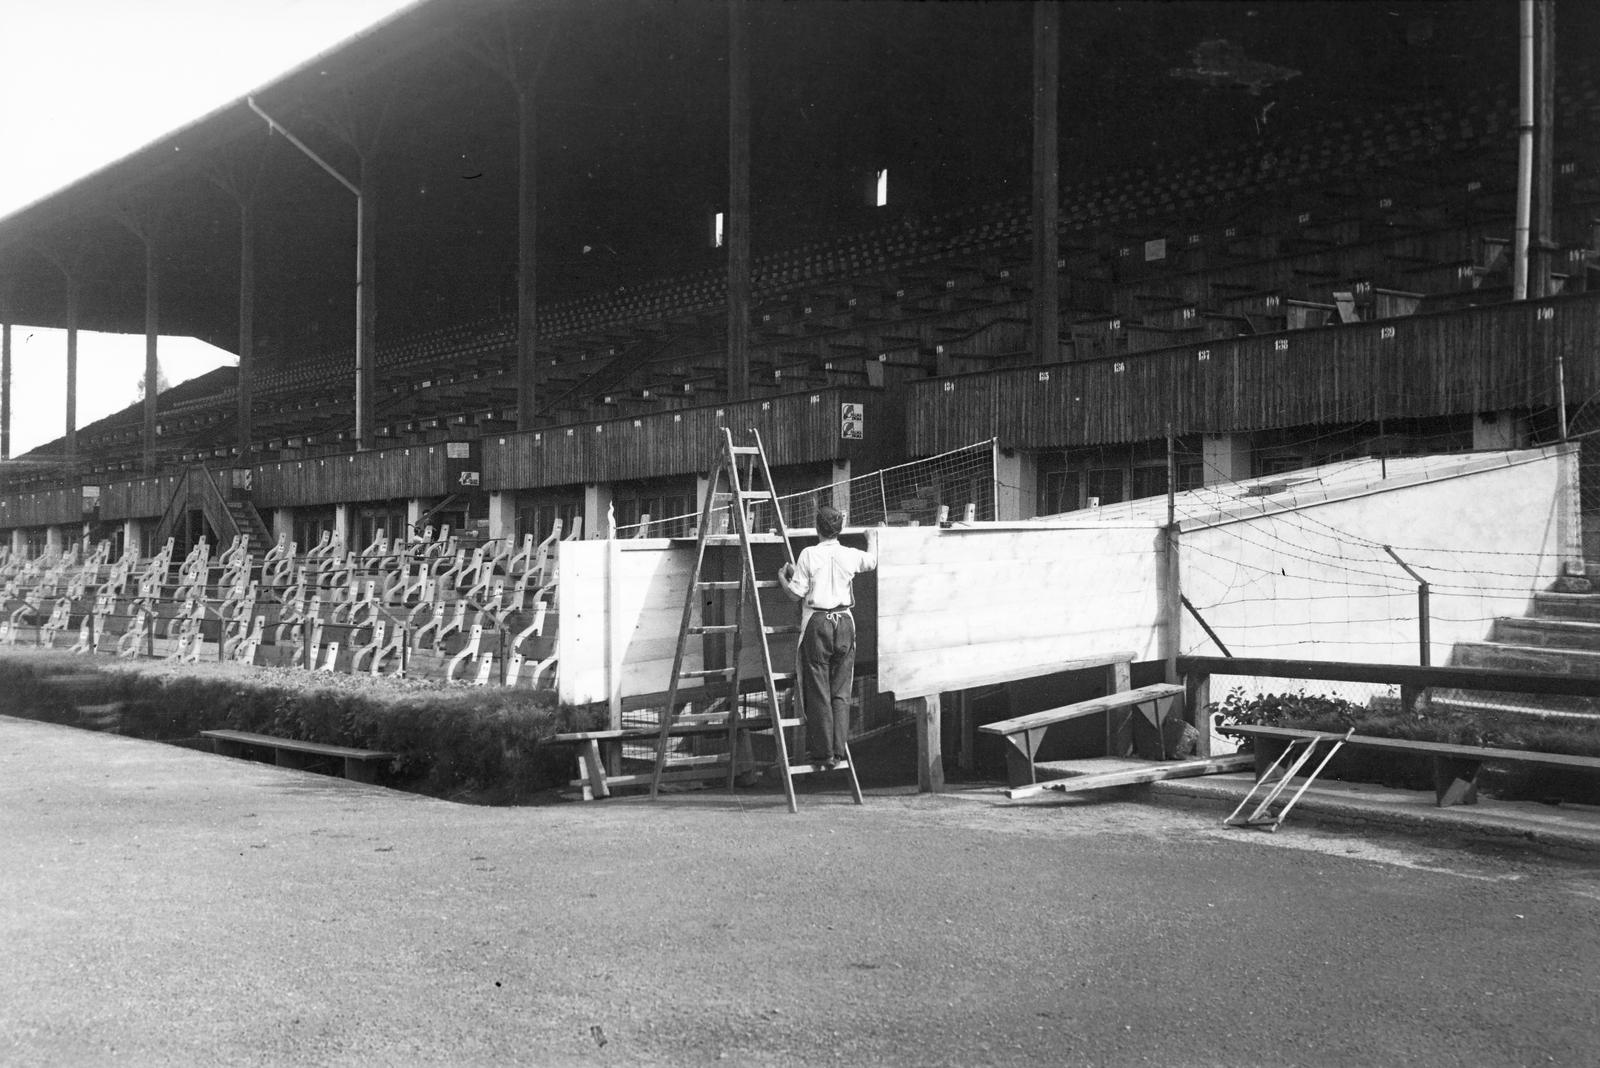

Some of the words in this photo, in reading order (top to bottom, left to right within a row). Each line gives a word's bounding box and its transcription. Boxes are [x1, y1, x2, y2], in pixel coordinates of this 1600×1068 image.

[1537, 307, 1554, 321] 140
[1381, 327, 1396, 340] 139
[1274, 339, 1289, 351] 138
[1198, 350, 1210, 361] 137
[1113, 362, 1125, 373] 136
[1038, 371, 1050, 381] 135
[944, 381, 955, 392] 134
